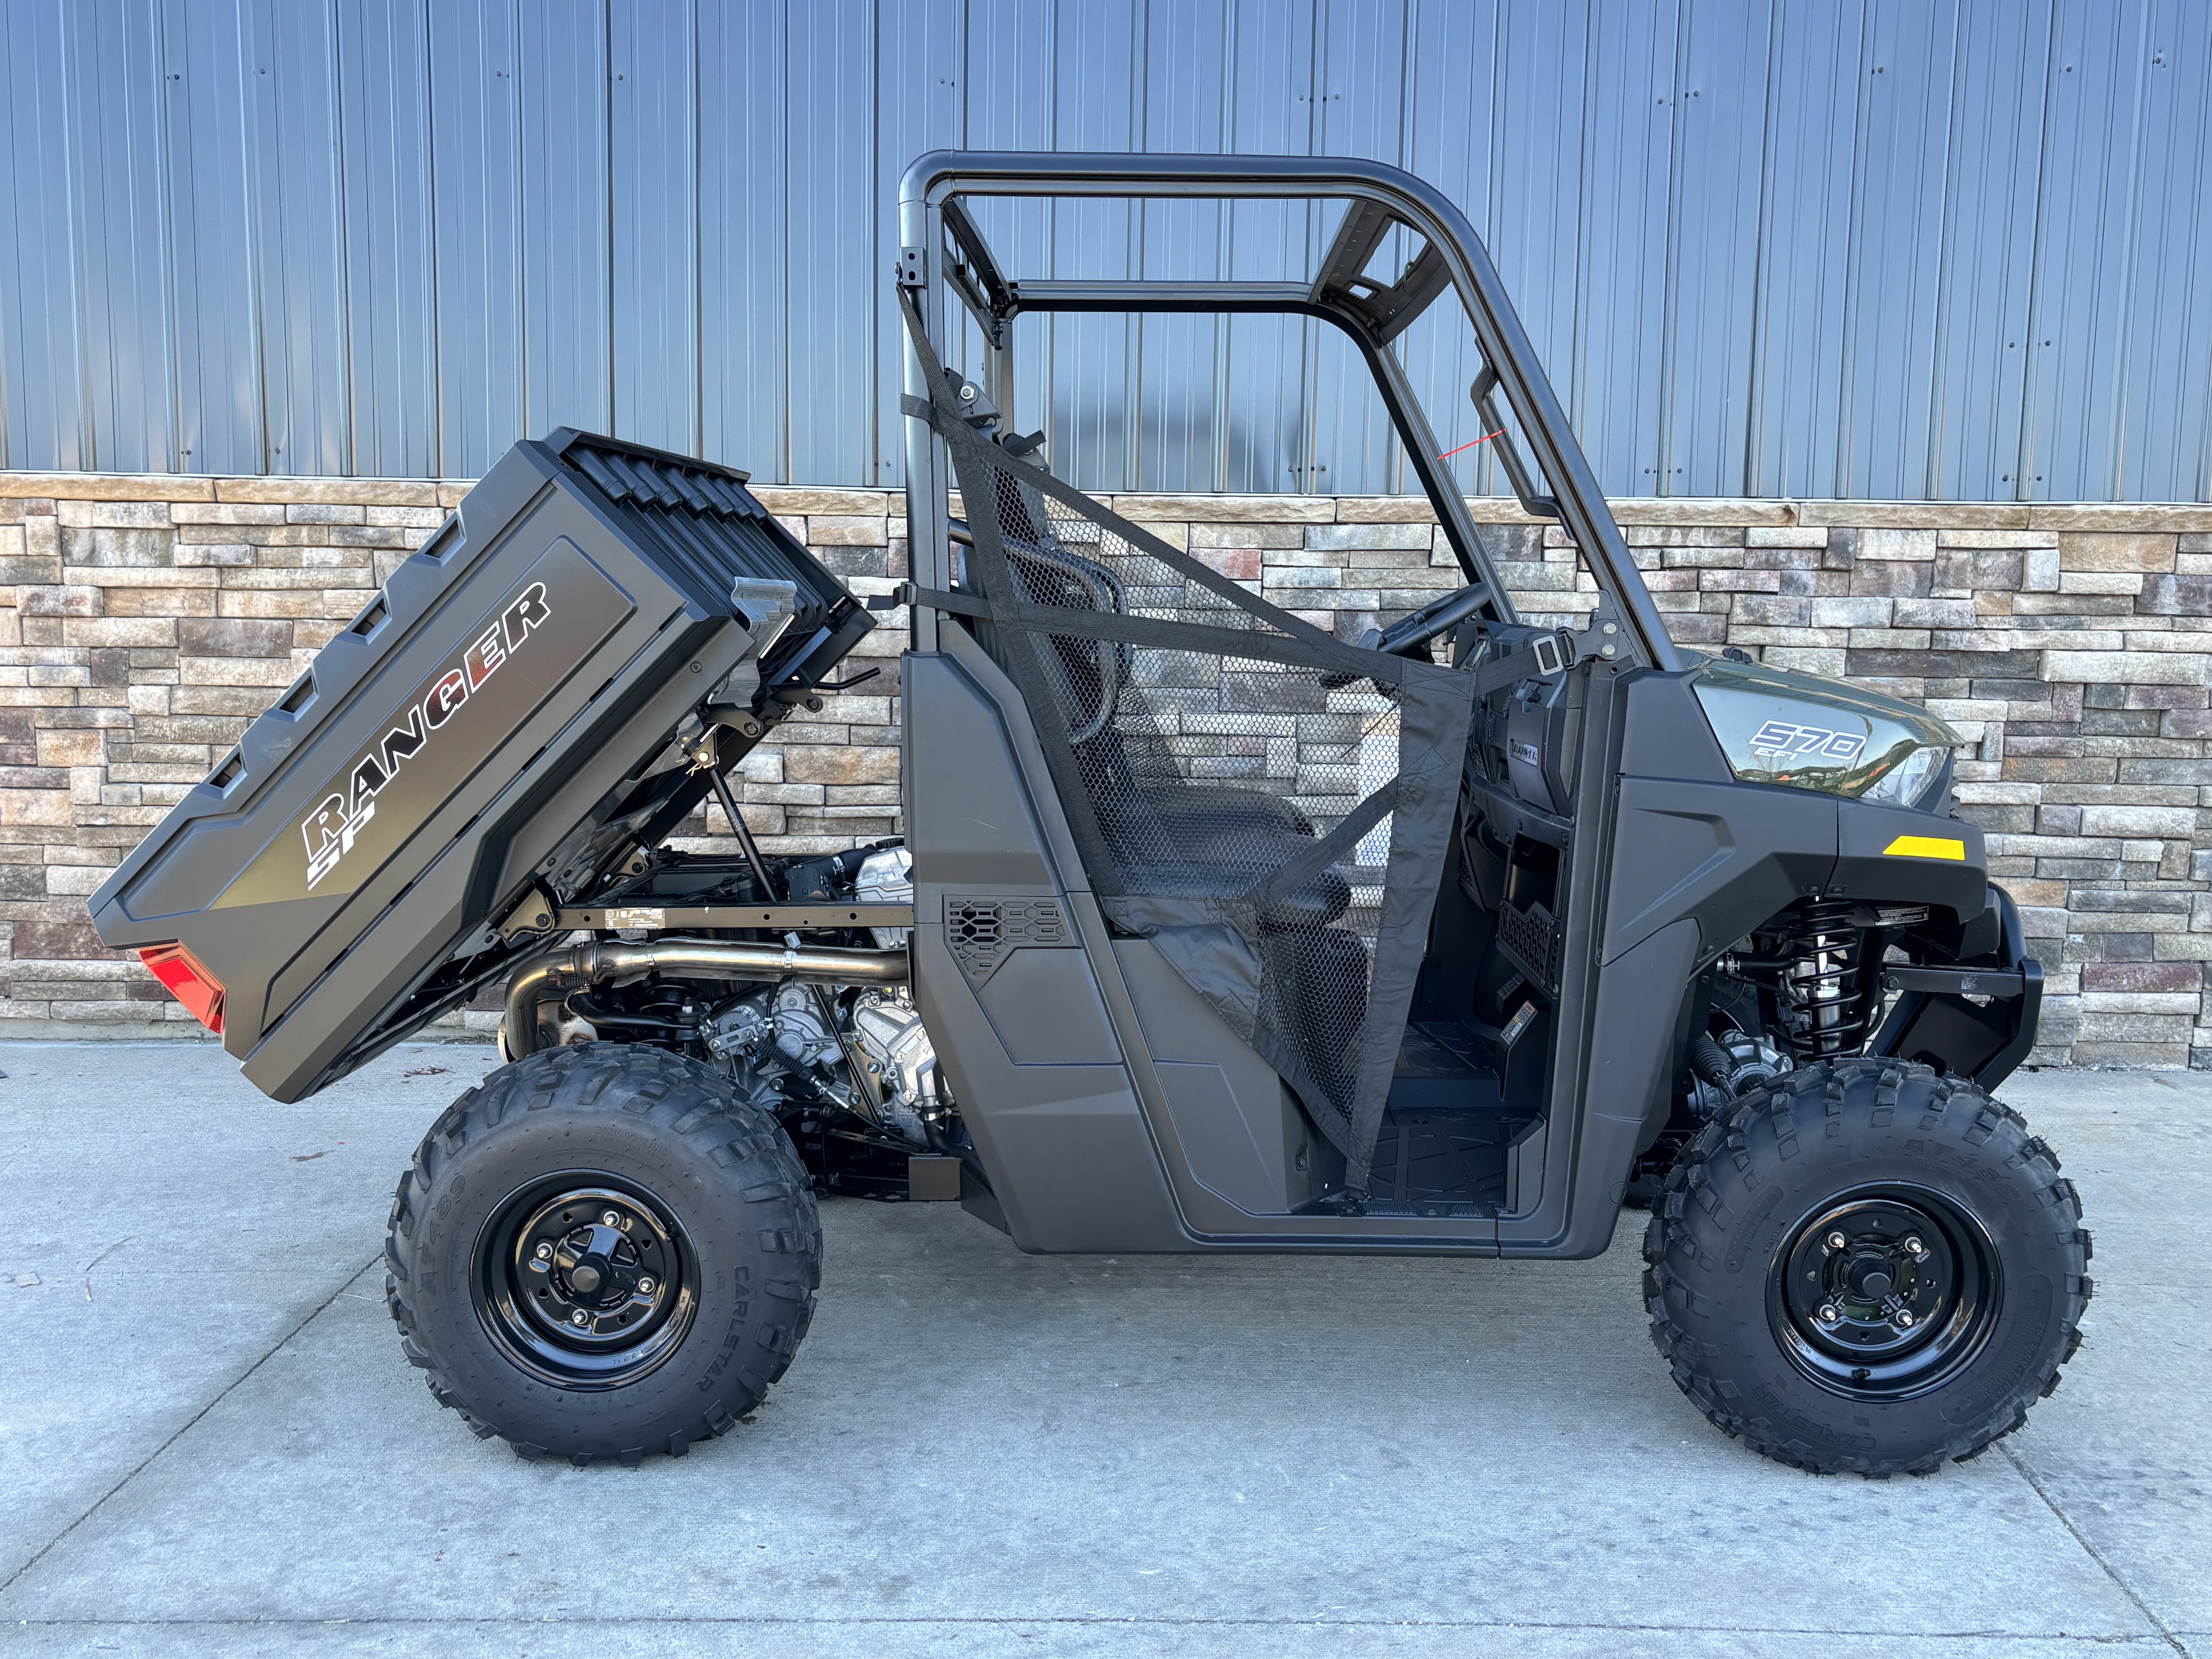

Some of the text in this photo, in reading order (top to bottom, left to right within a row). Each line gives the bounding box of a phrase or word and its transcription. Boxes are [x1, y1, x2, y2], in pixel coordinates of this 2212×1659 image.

[301, 581, 551, 863] RANGER
[1748, 720, 1867, 760] 570
[1754, 747, 1798, 761] EFI
[307, 800, 375, 891] SP
[694, 1266, 750, 1392] CARLSTAR
[1753, 1382, 1876, 1451] CARLSTAR
